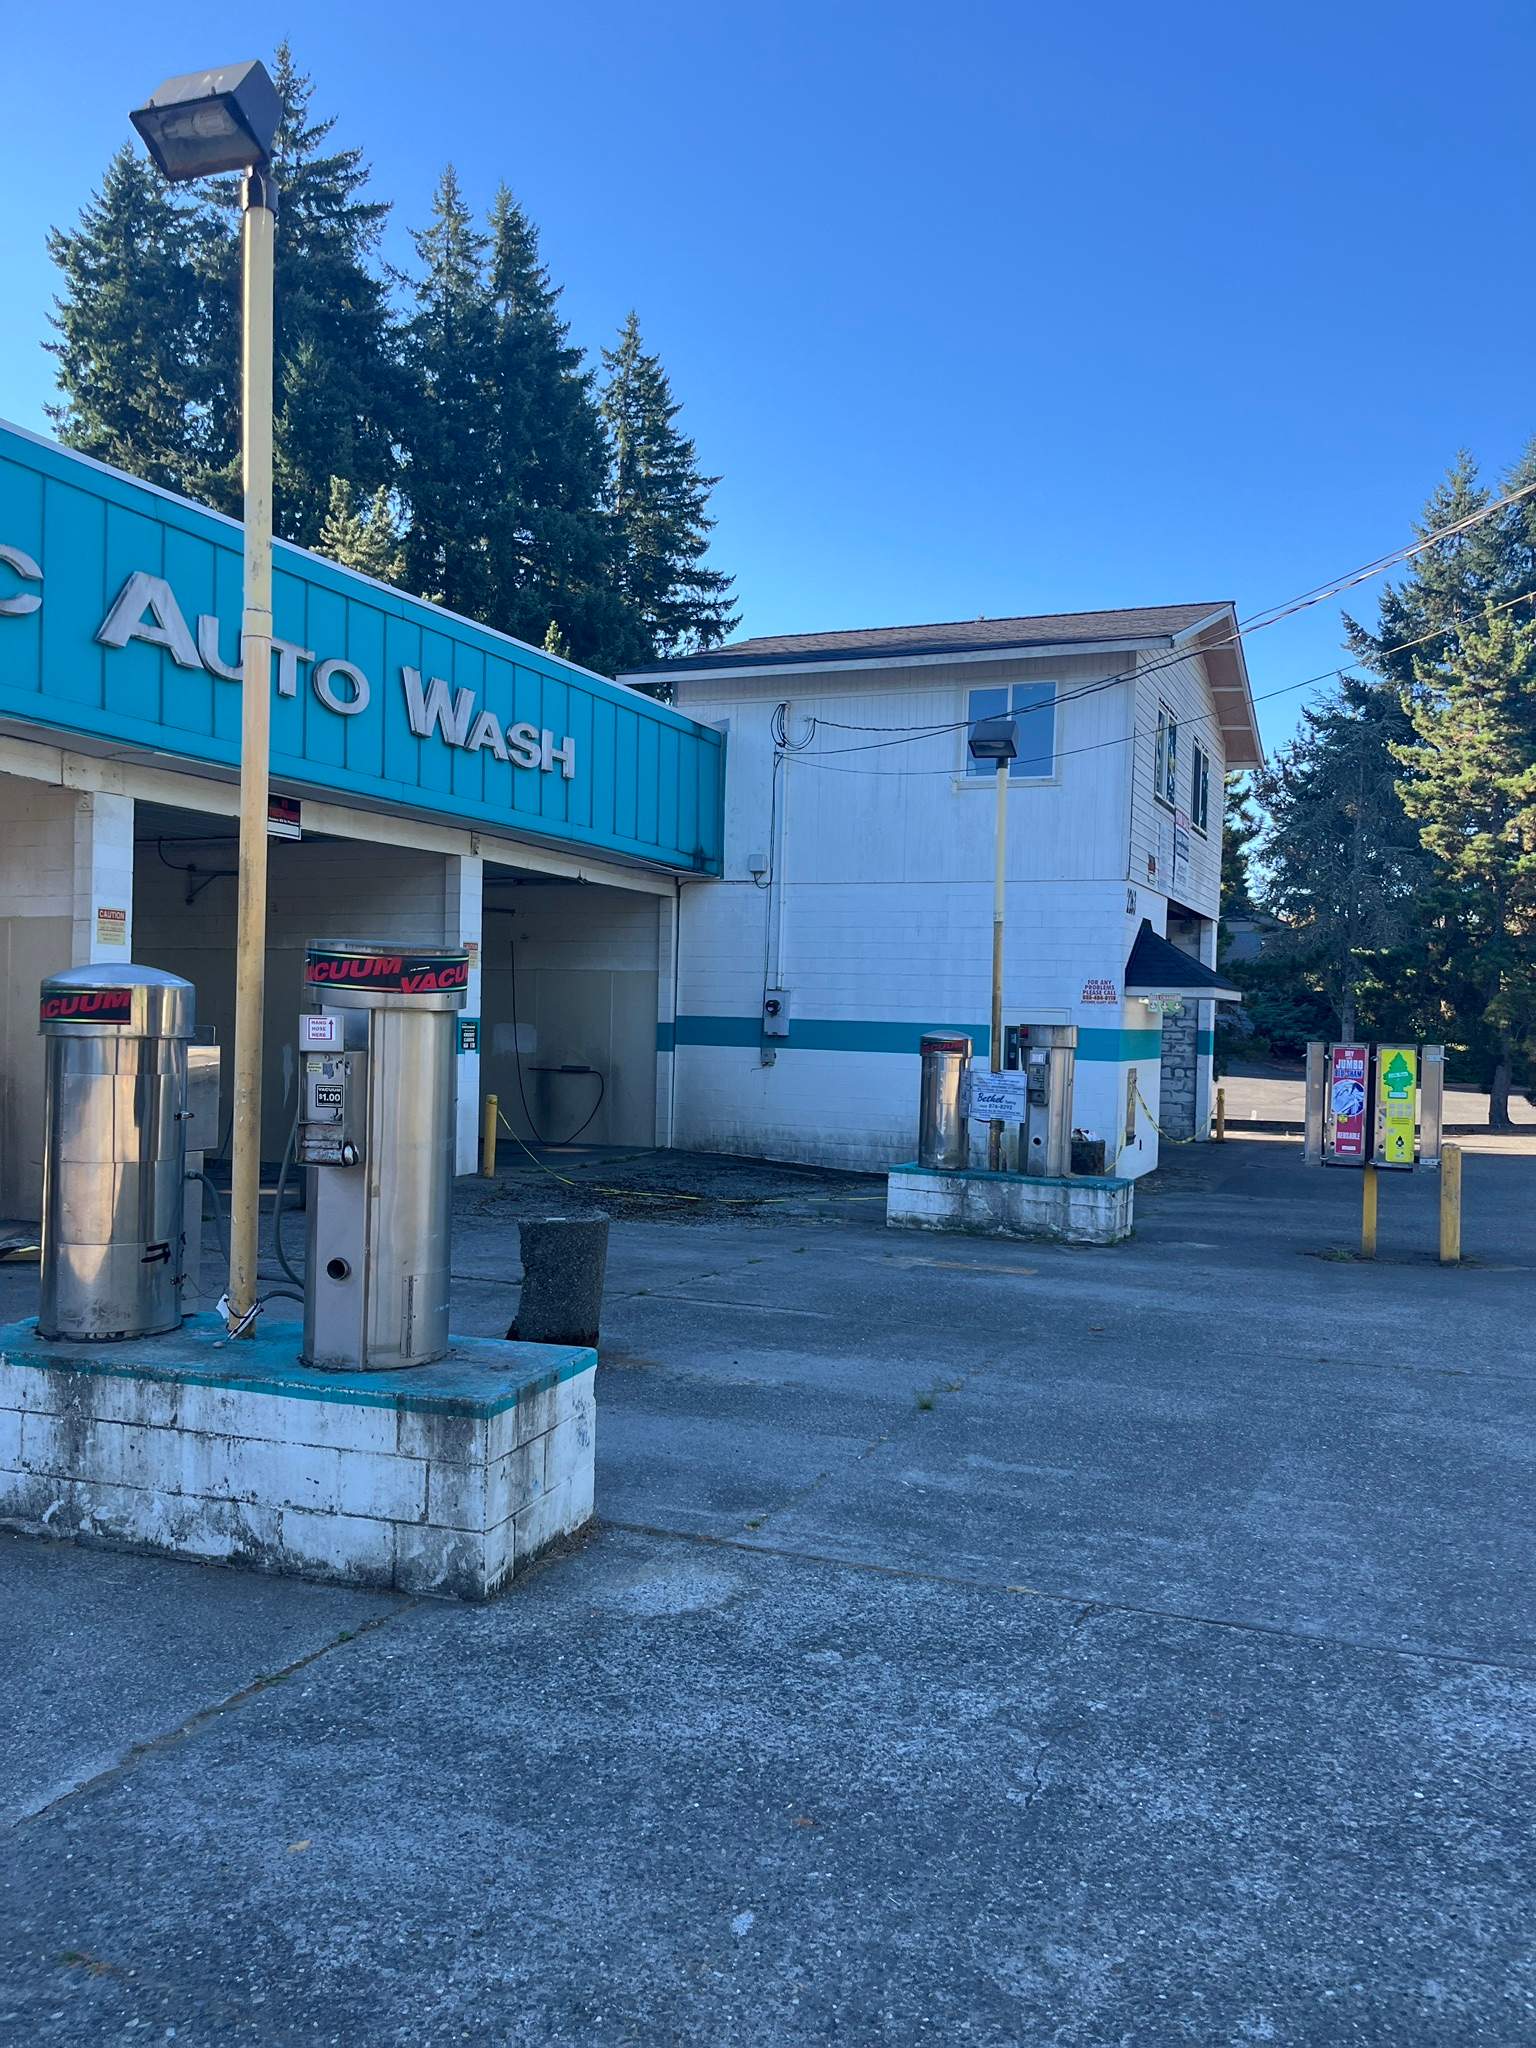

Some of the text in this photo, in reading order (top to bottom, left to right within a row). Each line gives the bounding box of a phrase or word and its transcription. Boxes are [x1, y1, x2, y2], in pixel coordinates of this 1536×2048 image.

[95, 571, 371, 716] AUTO
[402, 665, 576, 779] WASH
[99, 910, 125, 920] CAUTION
[400, 961, 468, 993] VACU
[1335, 1059, 1364, 1070] JUMBO
[318, 1093, 341, 1102] $1.00
